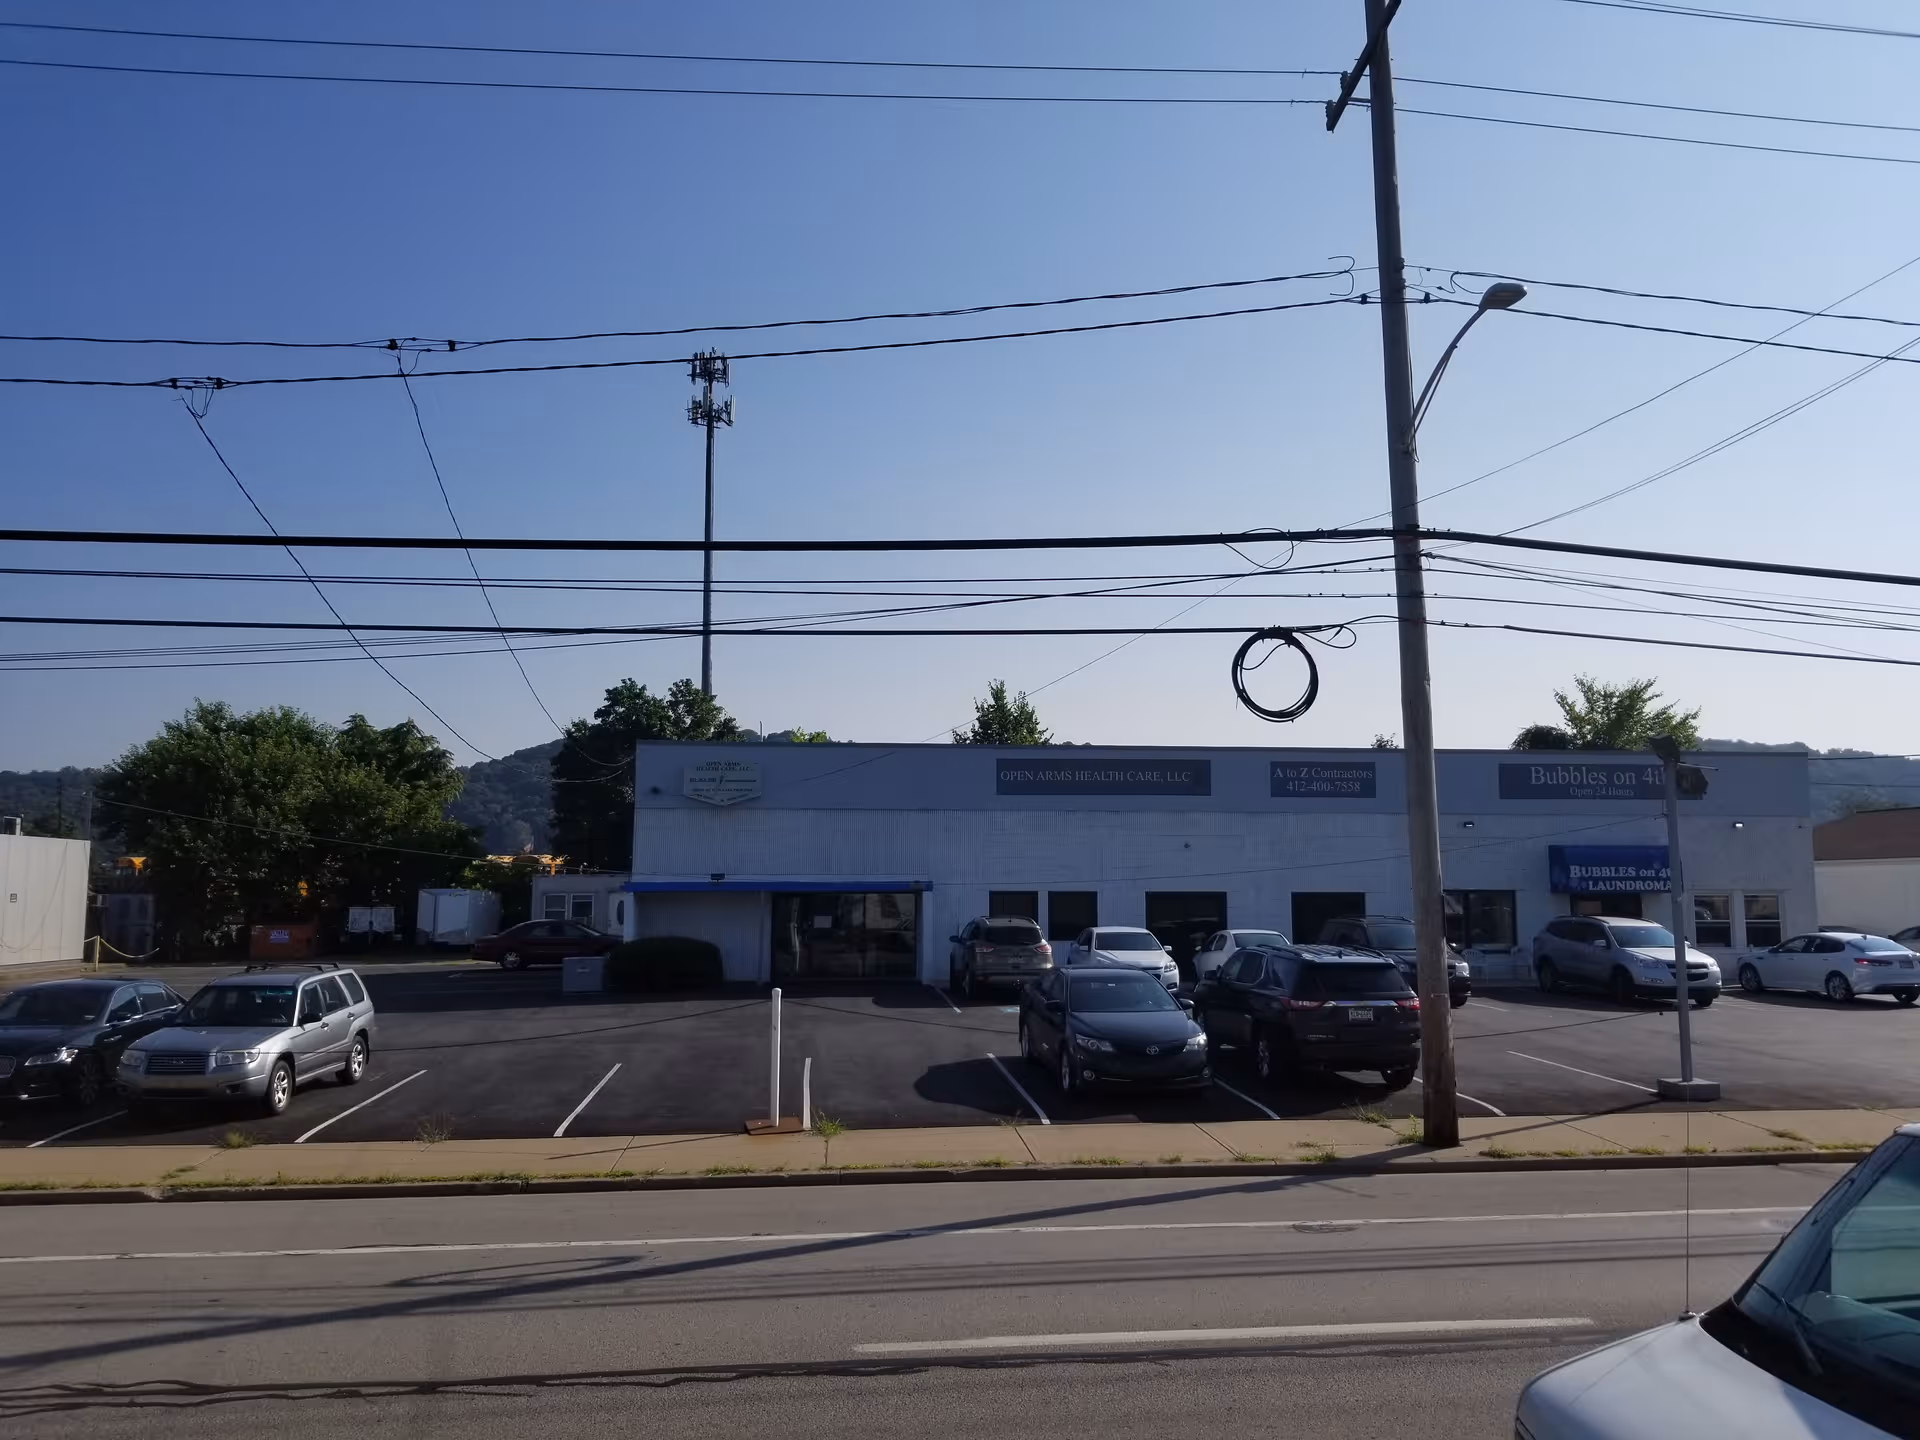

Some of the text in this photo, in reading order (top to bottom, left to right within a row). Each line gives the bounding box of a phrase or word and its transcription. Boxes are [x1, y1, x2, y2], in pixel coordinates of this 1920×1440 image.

[1000, 771, 1192, 783] OPEN ARMS HEALTH CARE, LLC
[1273, 767, 1373, 779] A to Z Contractors
[1530, 766, 1608, 785] Bubbles
[1613, 771, 1636, 785] on
[1286, 780, 1361, 792] 412-400-7558
[1570, 787, 1635, 798] Open 24 Hours
[1569, 865, 1637, 878] BUBBLES
[1639, 869, 1656, 877] on
[1587, 880, 1671, 891] LAUNDROMA
